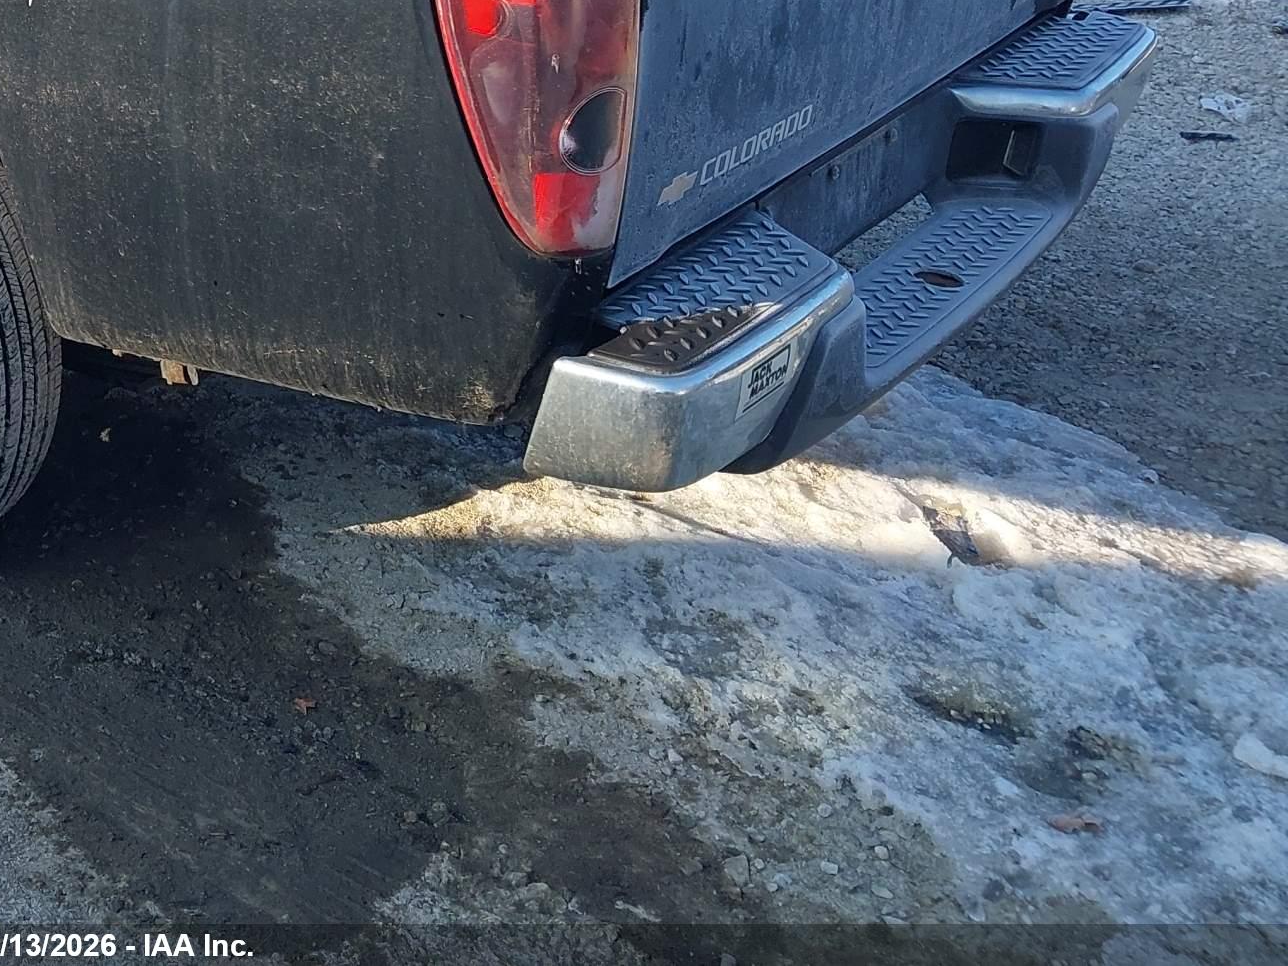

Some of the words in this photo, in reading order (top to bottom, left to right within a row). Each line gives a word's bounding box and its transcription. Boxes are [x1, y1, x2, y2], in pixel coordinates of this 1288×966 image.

[700, 104, 813, 185] COLORADO
[748, 361, 772, 388] JACK
[749, 364, 787, 398] MAXTON
